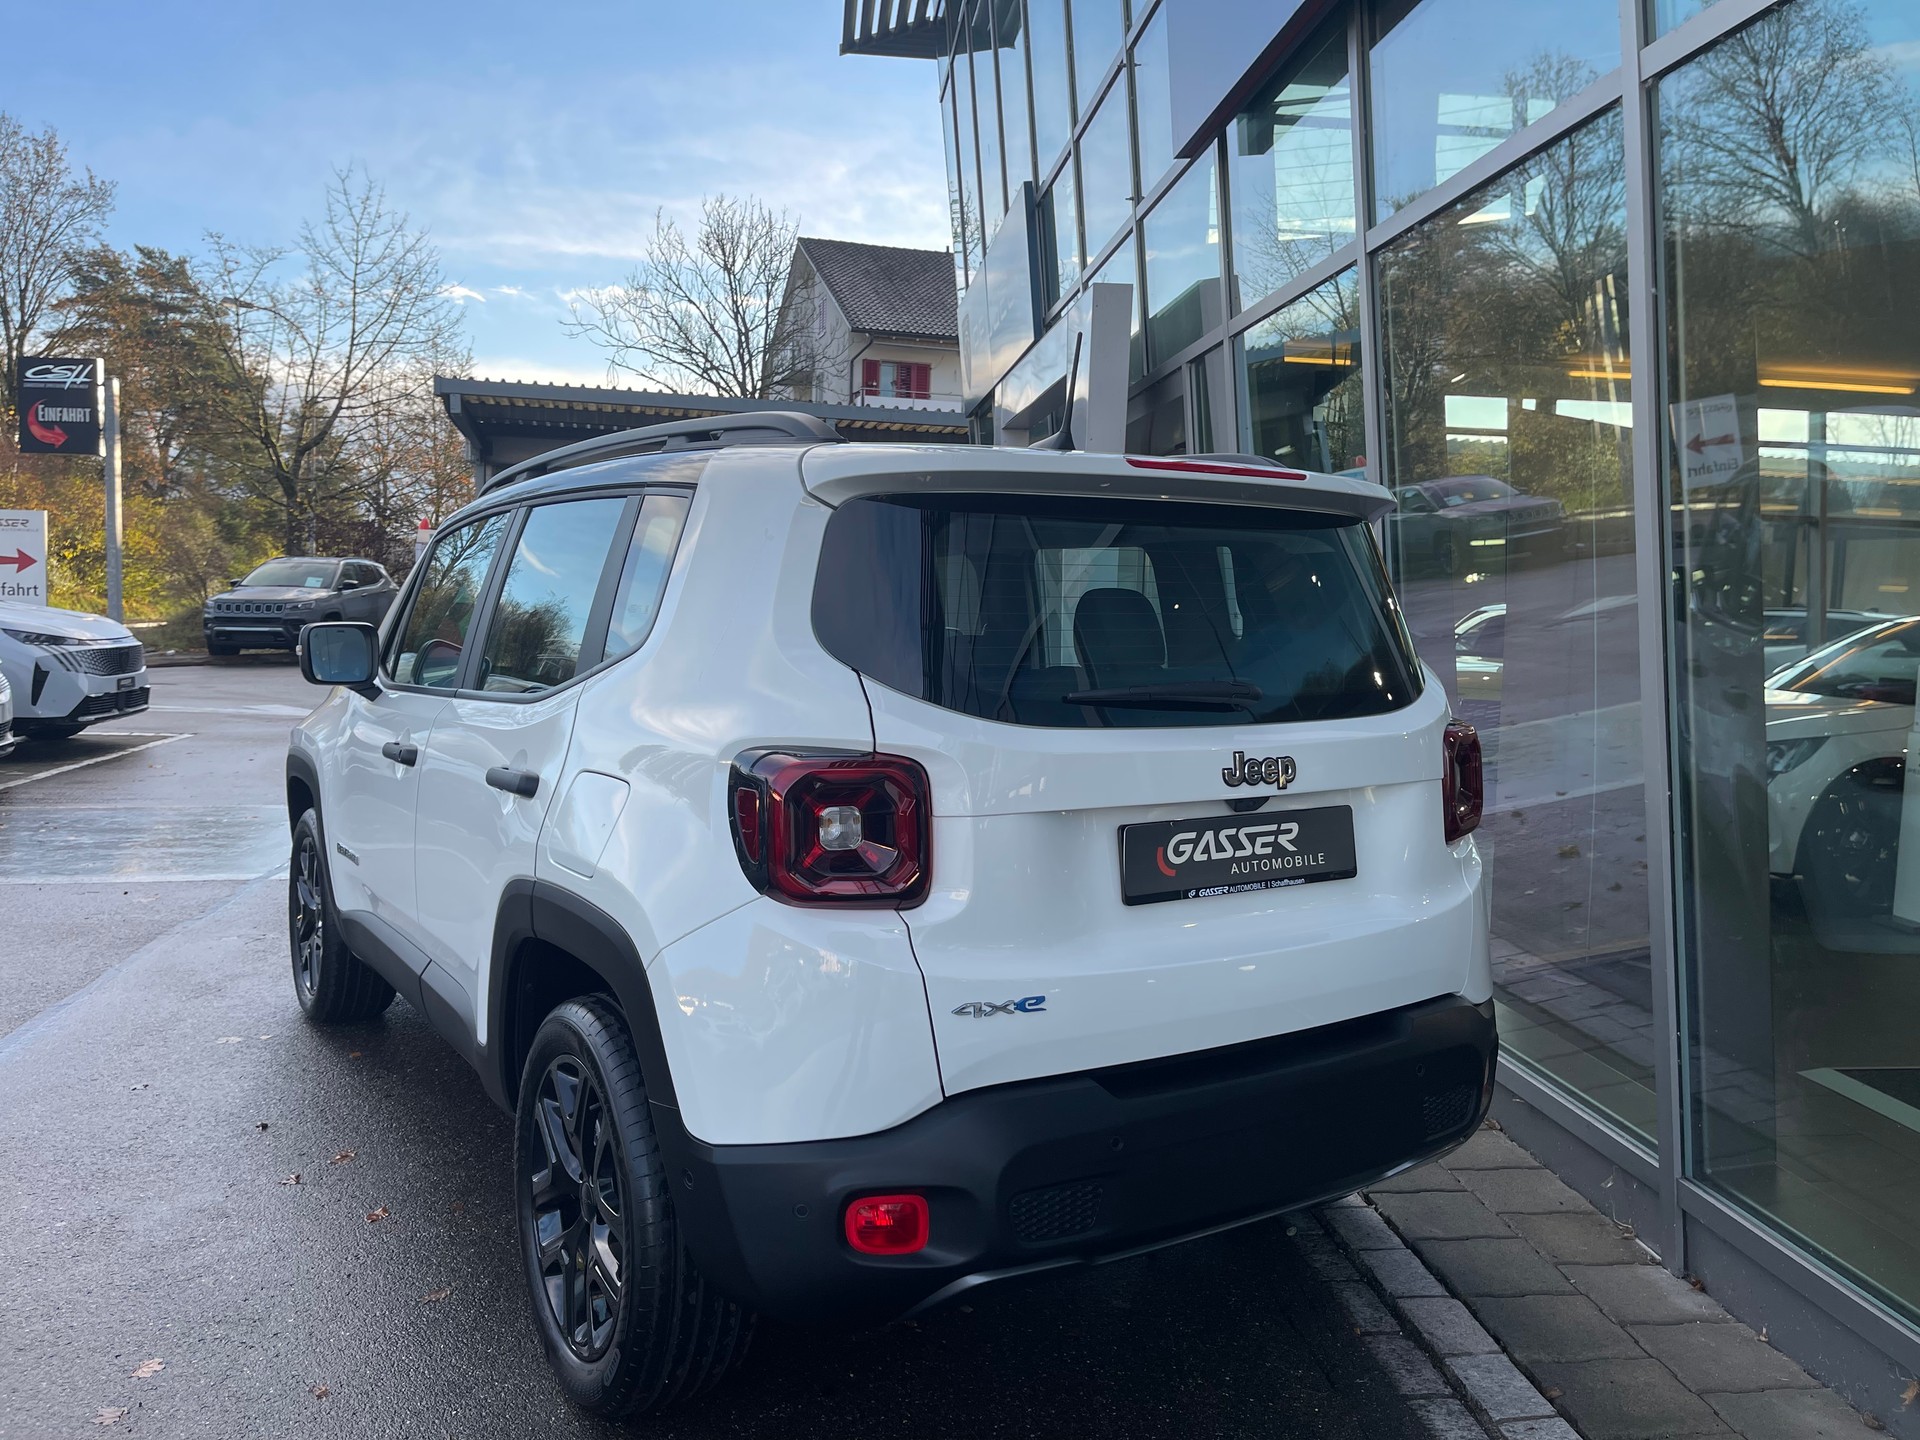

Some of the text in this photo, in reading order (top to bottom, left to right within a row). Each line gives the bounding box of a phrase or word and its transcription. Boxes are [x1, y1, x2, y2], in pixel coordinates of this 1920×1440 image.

[37, 404, 92, 423] EINFAHRT
[1222, 751, 1296, 790] Jeep
[1167, 822, 1299, 865] GASSER
[1230, 852, 1326, 875] AUTOMOBILE
[1198, 885, 1229, 898] GASSER
[1229, 881, 1267, 894] AUTOMOBILE
[1271, 877, 1306, 889] Schaffhausen
